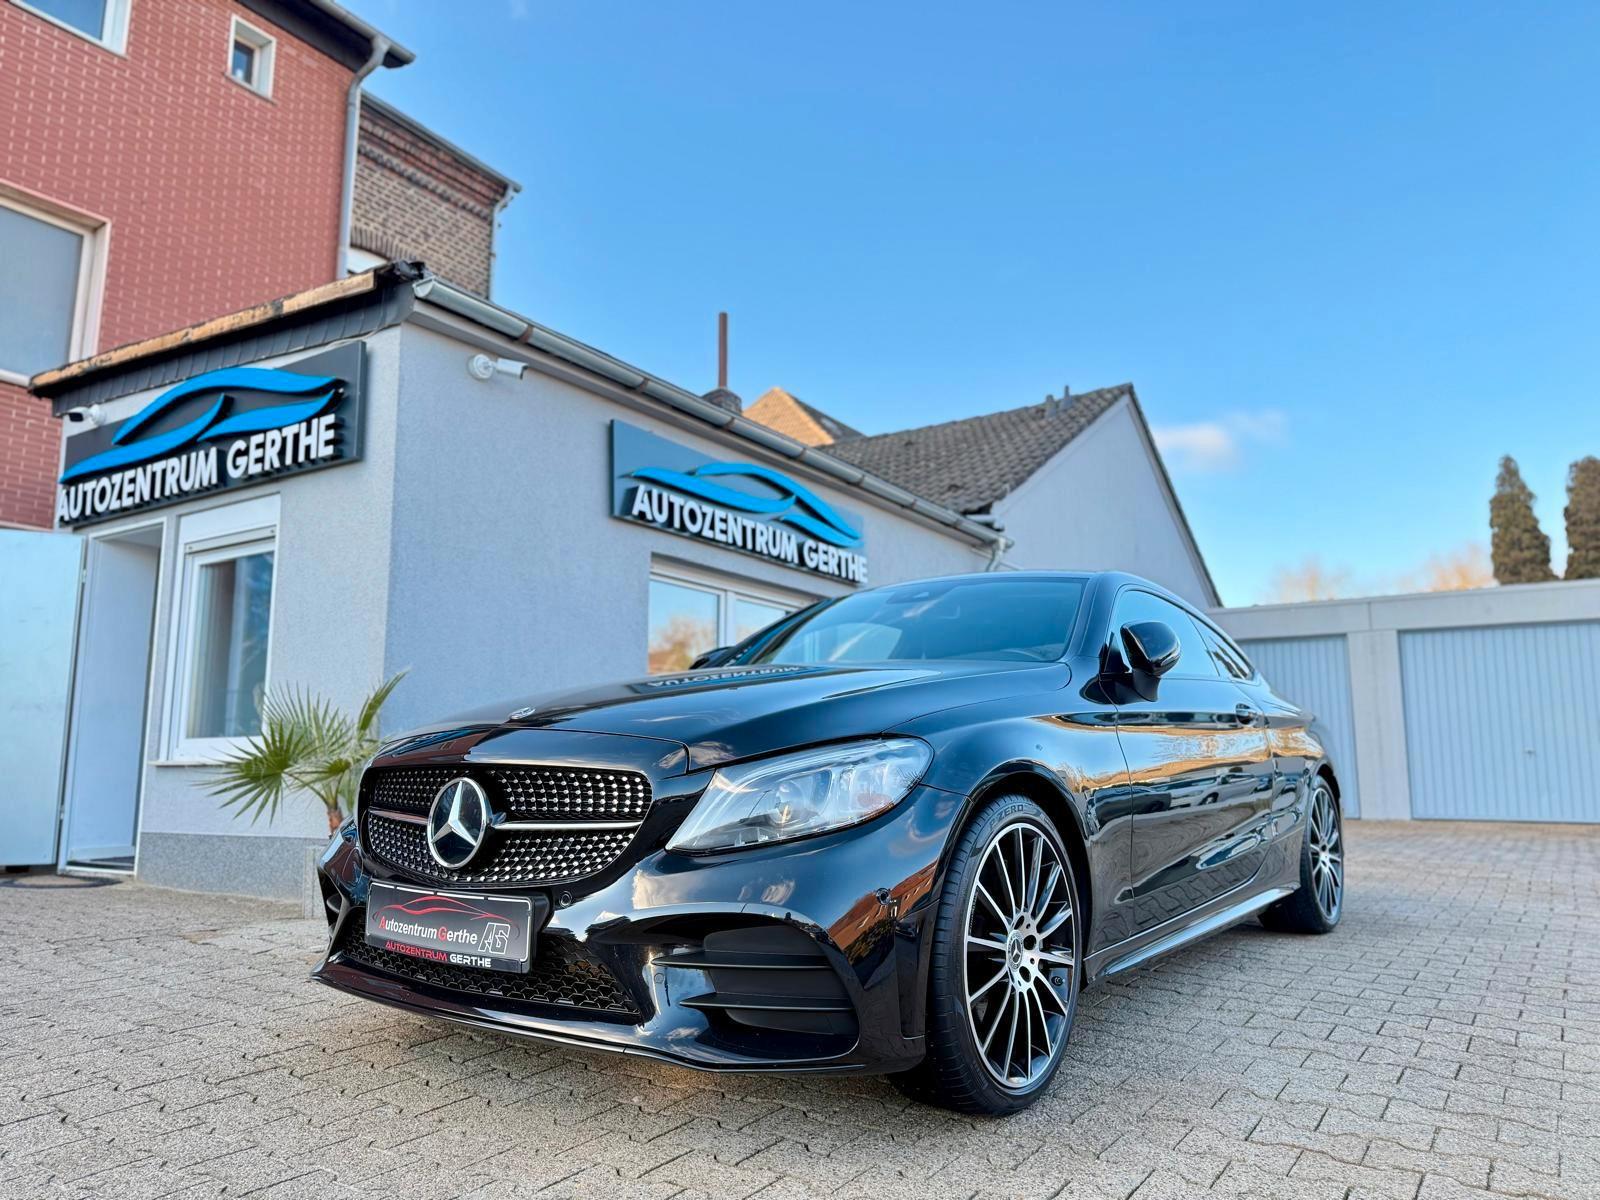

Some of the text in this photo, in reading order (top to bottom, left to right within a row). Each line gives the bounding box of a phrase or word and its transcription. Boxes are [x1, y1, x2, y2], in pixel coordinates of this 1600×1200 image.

[57, 413, 336, 522] AUTOZENTRUM GERTHE
[631, 484, 868, 583] AUTOZENTRUM GERTHE
[385, 939, 492, 968] AUTOZENTRUM GERTHE
